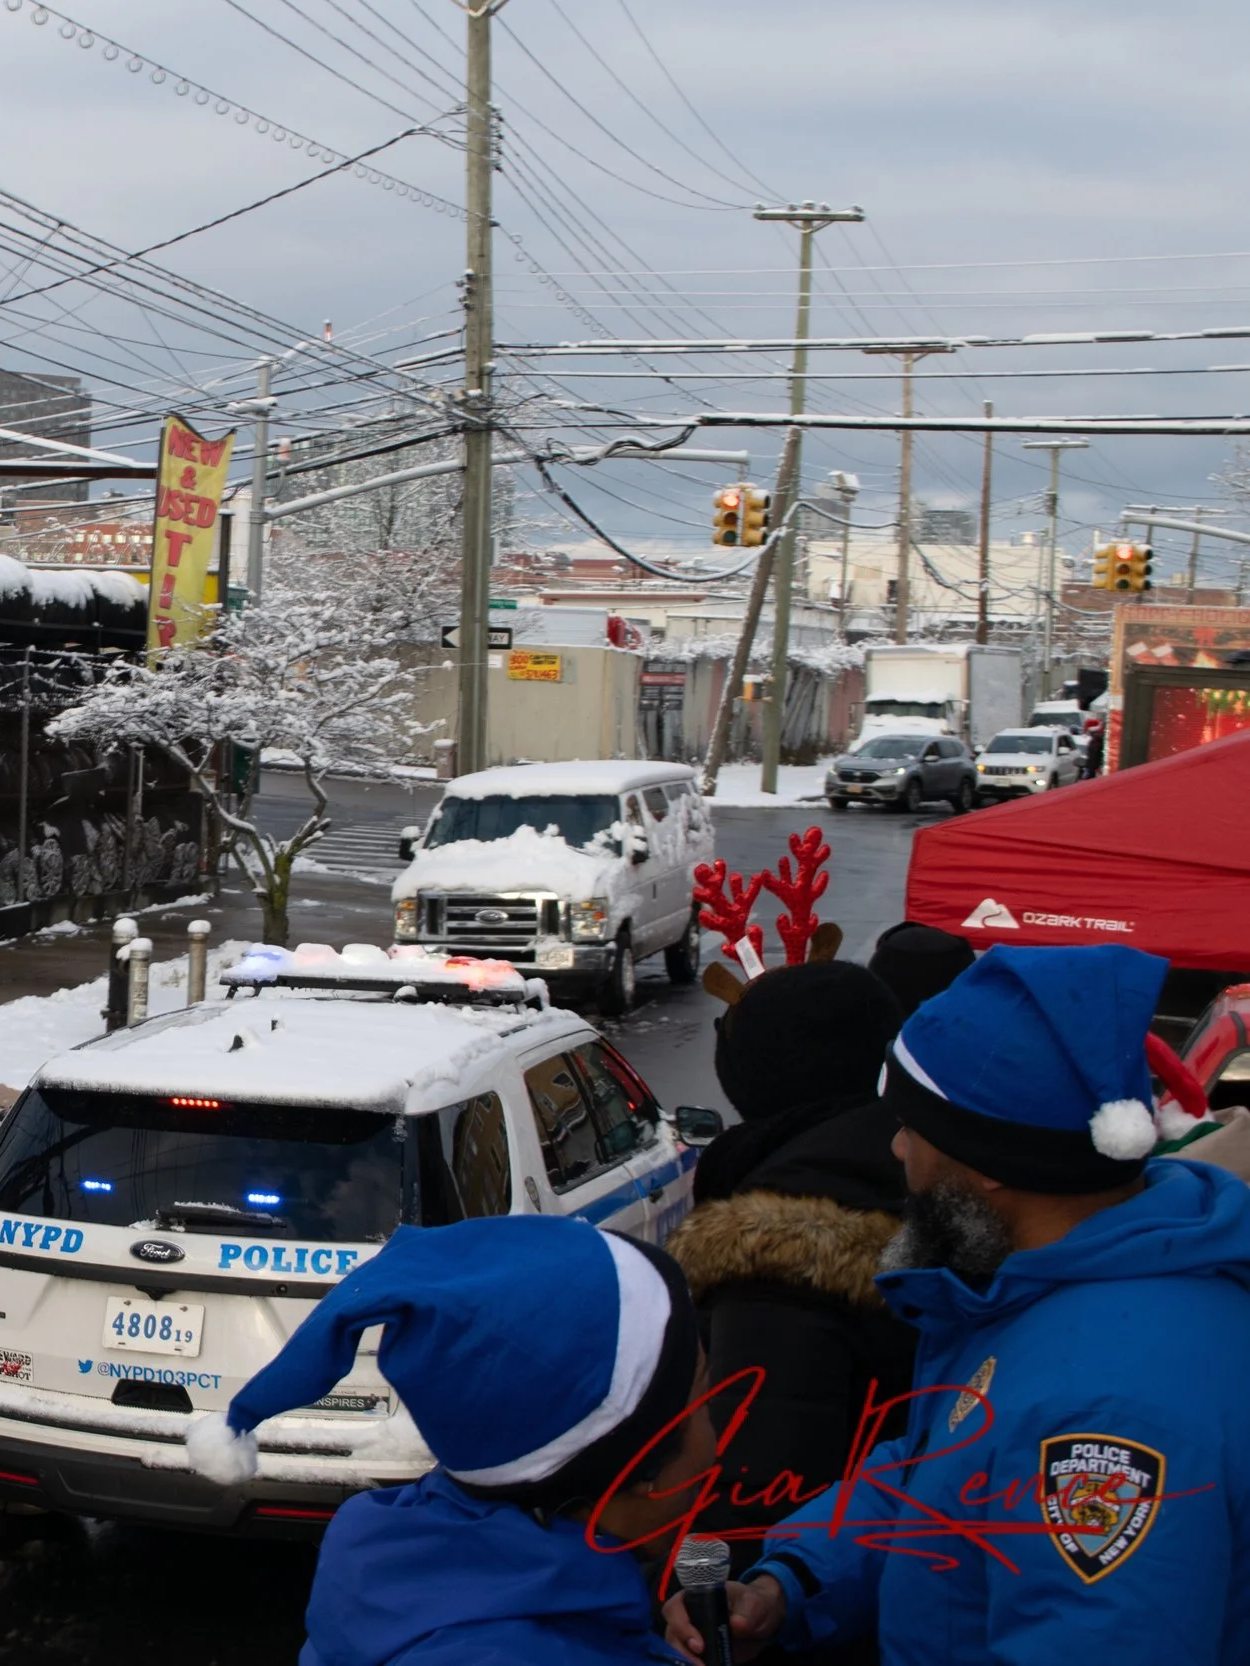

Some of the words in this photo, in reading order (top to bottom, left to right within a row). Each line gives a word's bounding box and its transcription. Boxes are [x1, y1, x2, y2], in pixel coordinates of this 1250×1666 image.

[168, 424, 227, 467] NEW
[180, 465, 197, 490] &
[157, 485, 217, 529] USED
[1084, 918, 1134, 932] TRAIL
[140, 1242, 171, 1259] Ford
[218, 1244, 358, 1276] POLICE
[112, 1312, 173, 1341] 4808
[174, 1329, 193, 1343] 19
[96, 1361, 222, 1389] @NYPD103PCT
[1071, 1443, 1131, 1466] POLICE
[1050, 1458, 1152, 1488] DEPARTMENT
[1059, 1532, 1080, 1554] OF
[1098, 1538, 1129, 1566] NEW
